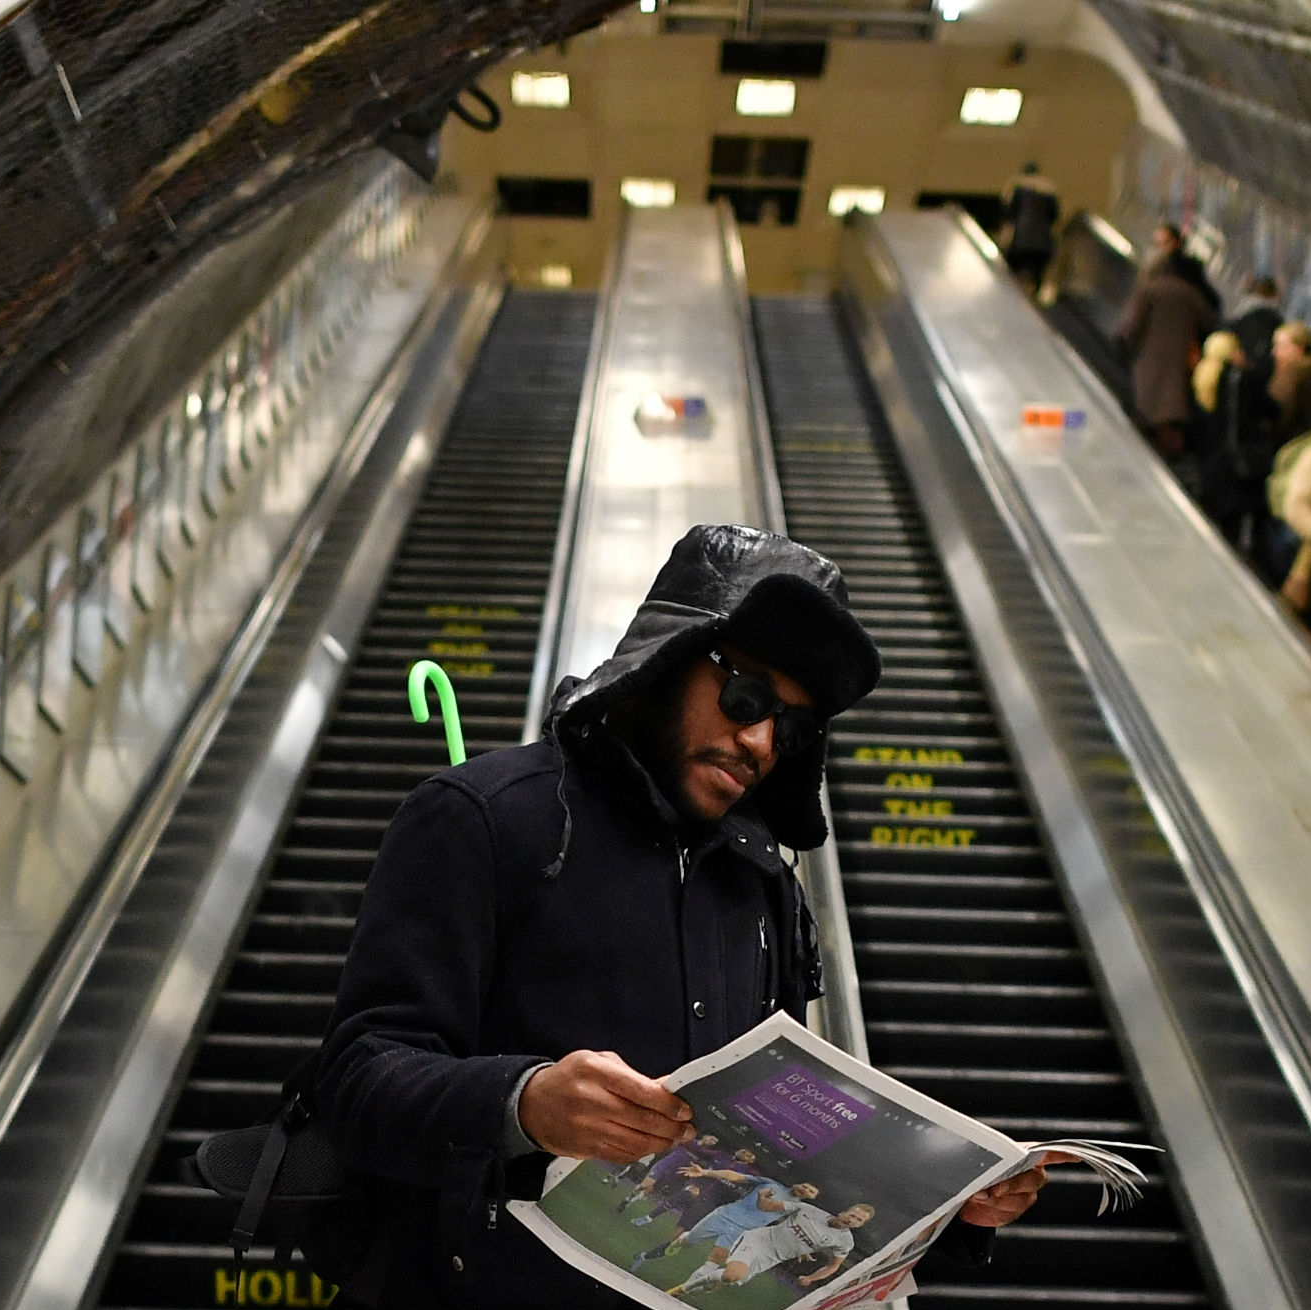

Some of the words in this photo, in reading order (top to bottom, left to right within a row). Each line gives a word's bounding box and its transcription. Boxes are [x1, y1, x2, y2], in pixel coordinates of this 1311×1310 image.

[885, 773, 933, 792] ON
[883, 799, 953, 818] THE
[871, 826, 975, 848] RIGHT
[772, 1082, 791, 1096] for
[790, 1093, 803, 1103] 6
[799, 1100, 841, 1129] months
[785, 1073, 808, 1087] BT
[801, 1083, 835, 1106] Sport
[831, 1102, 858, 1121] free
